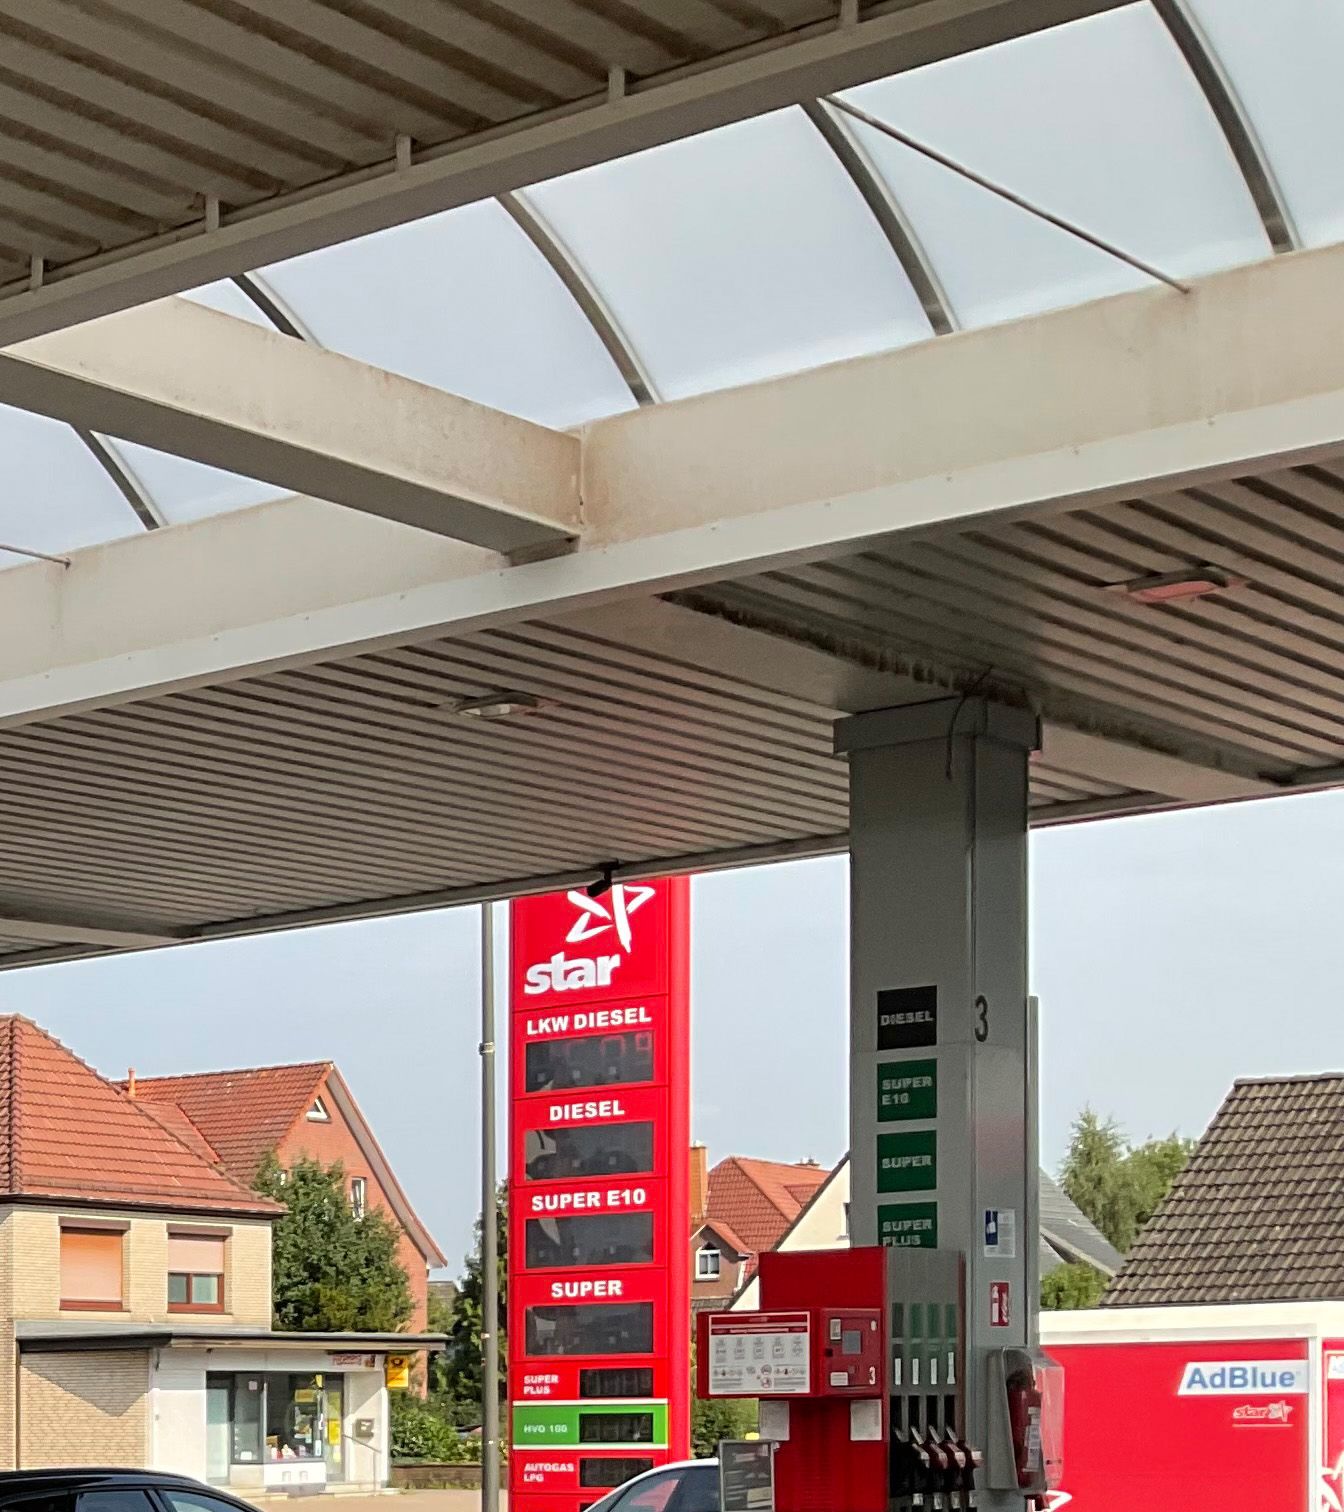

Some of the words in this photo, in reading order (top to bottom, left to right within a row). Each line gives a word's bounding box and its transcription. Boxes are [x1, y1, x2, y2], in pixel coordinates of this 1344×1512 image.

[524, 951, 620, 994] star
[527, 1016, 568, 1035] LKW
[574, 1007, 651, 1029] DIESEL
[880, 1010, 933, 1026] DIESEL
[975, 995, 988, 1042] 3
[882, 1076, 932, 1090] SUPER
[882, 1093, 909, 1105] E10
[550, 1100, 625, 1121] DIESEL
[882, 1155, 931, 1168] SUPER
[532, 1192, 600, 1211] SUPER
[607, 1189, 646, 1205] E10
[882, 1220, 932, 1231] SUPER
[551, 1280, 623, 1297] SUPER
[524, 1375, 559, 1383] SUPER
[869, 1366, 876, 1384] 3
[1187, 1367, 1296, 1389] AdBlue
[524, 1386, 550, 1394] PLUS
[1234, 1405, 1268, 1418] star
[524, 1425, 545, 1433] HVO
[524, 1463, 574, 1472] AUTOGAS
[524, 1474, 544, 1482] LPG
